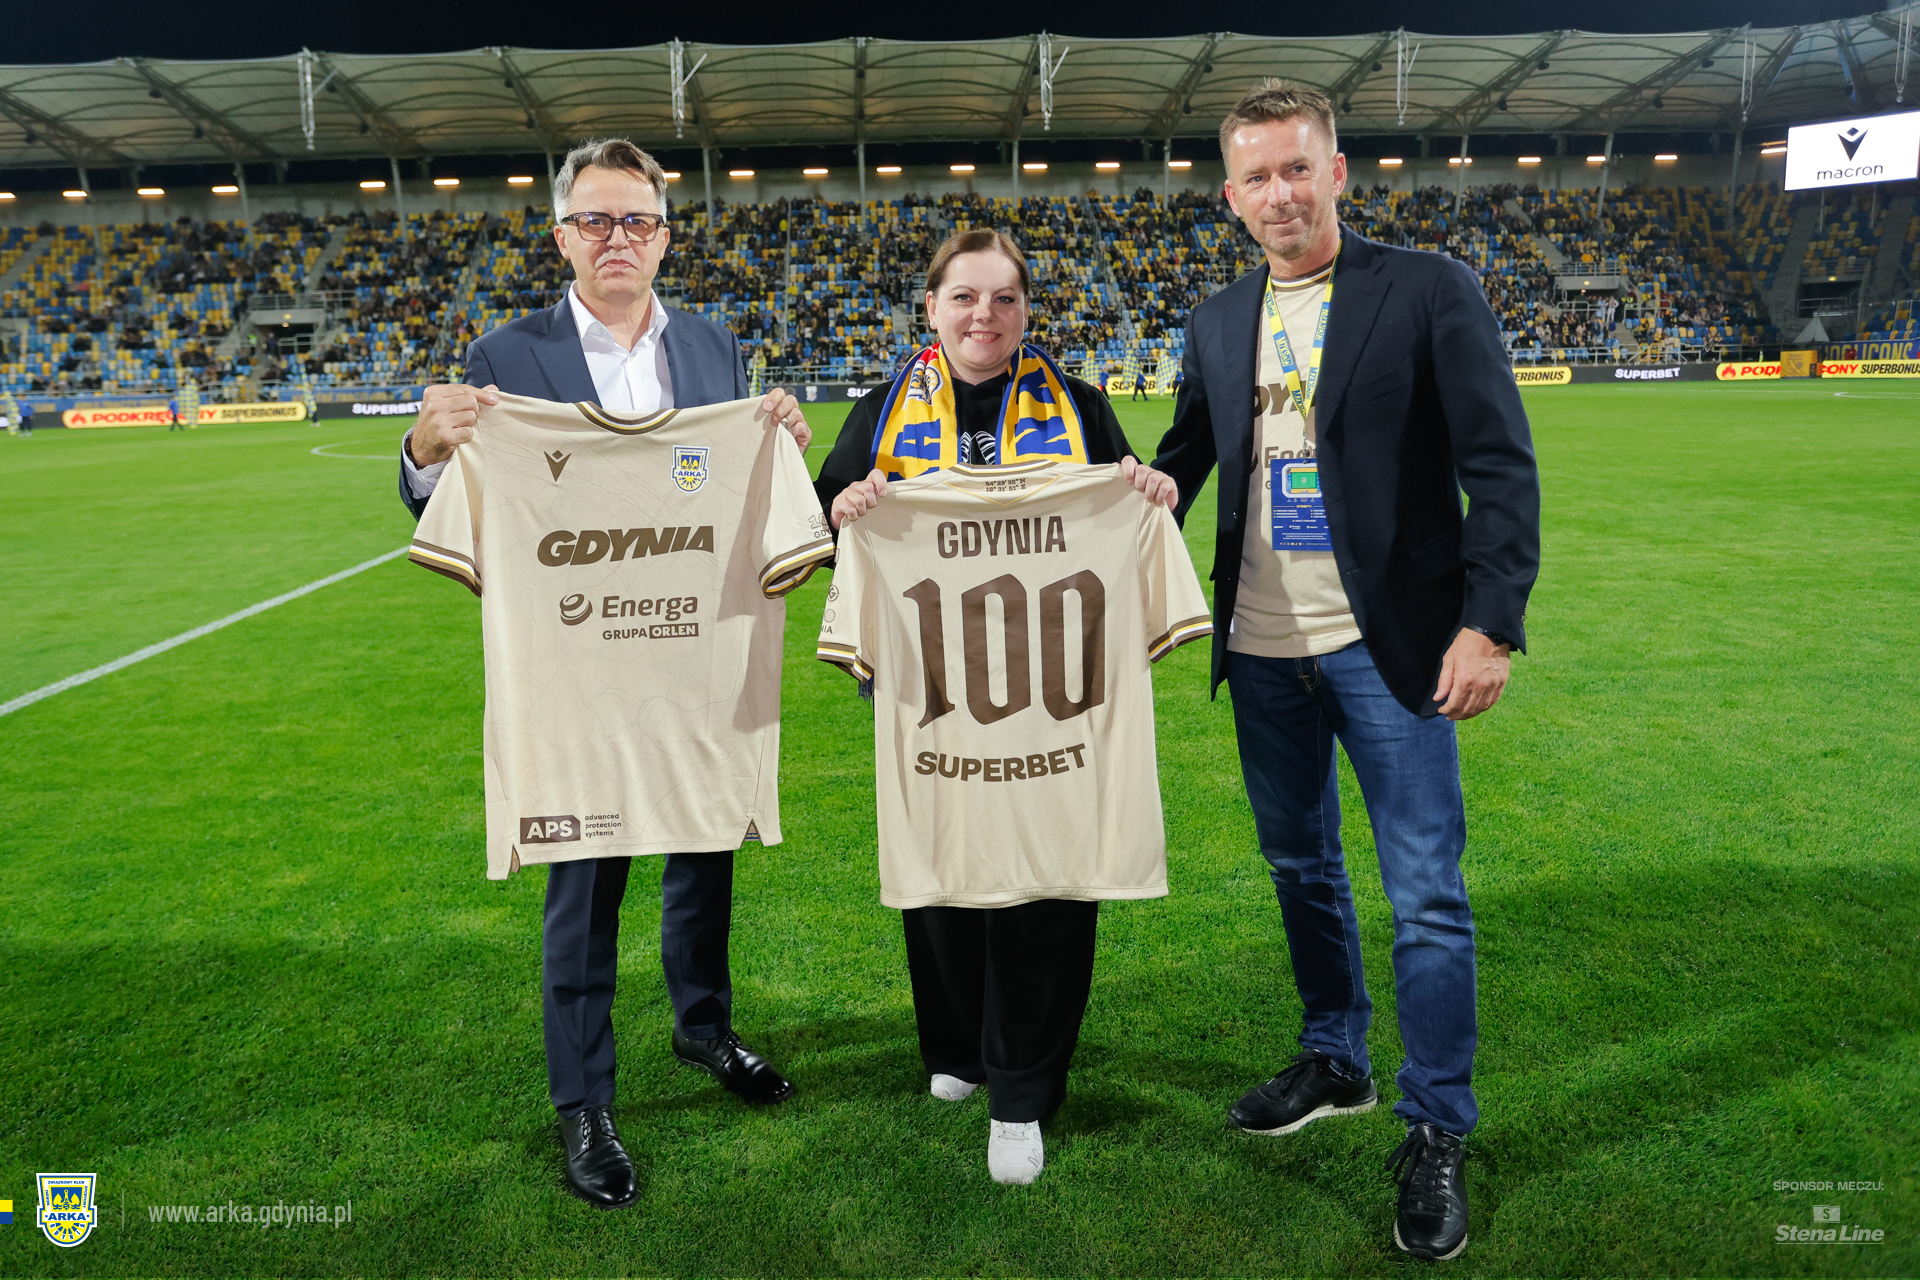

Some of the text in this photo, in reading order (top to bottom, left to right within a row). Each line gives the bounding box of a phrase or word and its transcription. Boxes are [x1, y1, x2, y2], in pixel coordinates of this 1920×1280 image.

[1817, 164, 1883, 180] macron
[1615, 367, 1680, 379] SUPERBET
[537, 525, 714, 567] GDYNIA
[937, 515, 1067, 559] GDYNIA
[602, 595, 698, 621] Energa
[602, 624, 697, 640] GRUPA ORLEN
[903, 569, 1105, 730] 100
[914, 743, 1086, 782] SUPERBET
[584, 813, 620, 821] advanced
[585, 821, 622, 829] protection
[526, 819, 574, 839] APS
[585, 829, 614, 838] systems
